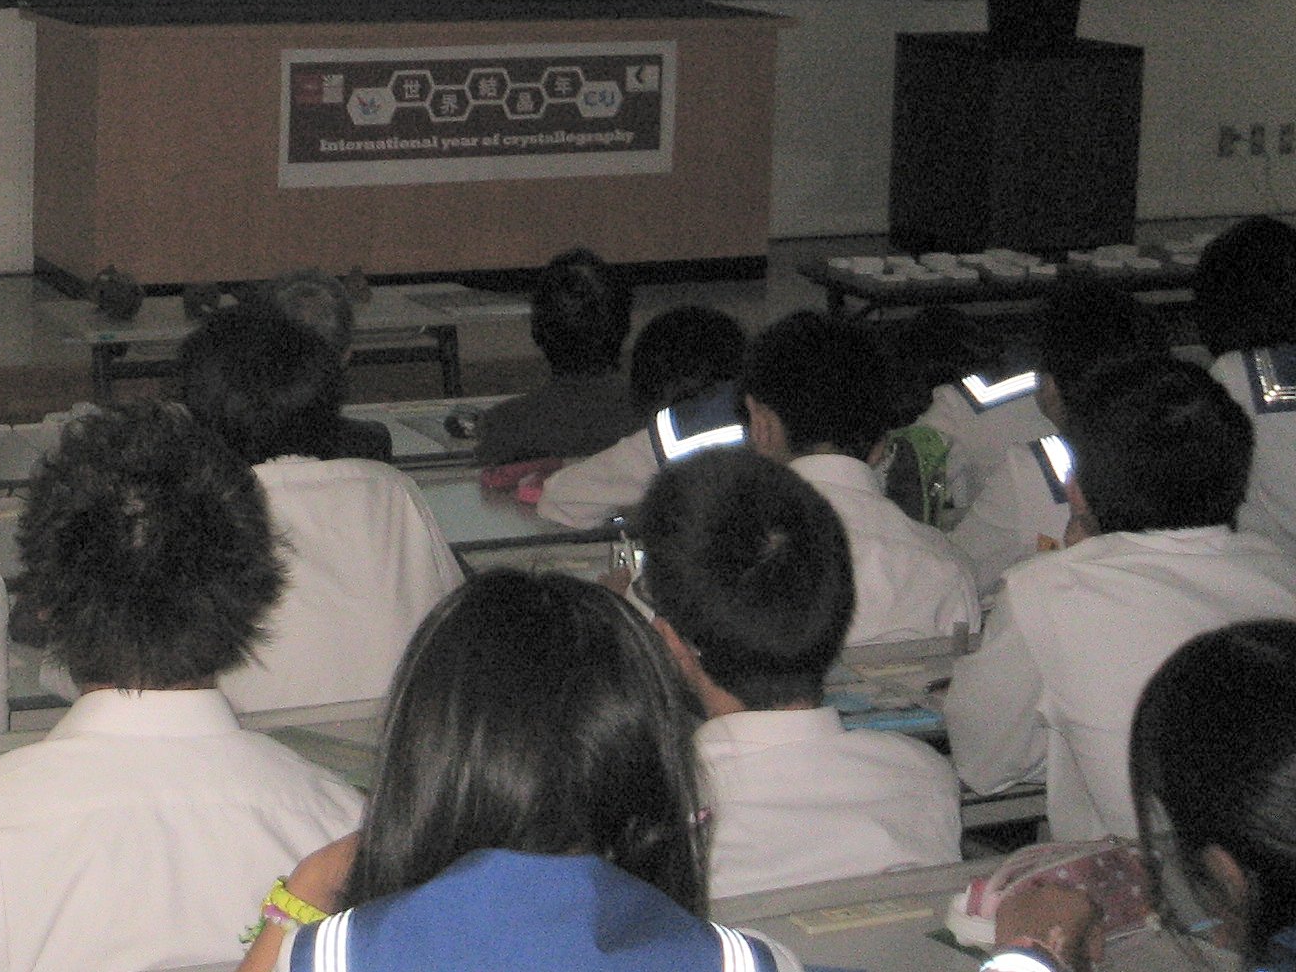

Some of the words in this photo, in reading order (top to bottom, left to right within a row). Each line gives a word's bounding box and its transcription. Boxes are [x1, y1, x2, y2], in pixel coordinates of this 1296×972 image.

[319, 135, 439, 152] International
[440, 136, 479, 151] year
[482, 133, 500, 147] of
[502, 130, 635, 149] crystallography
